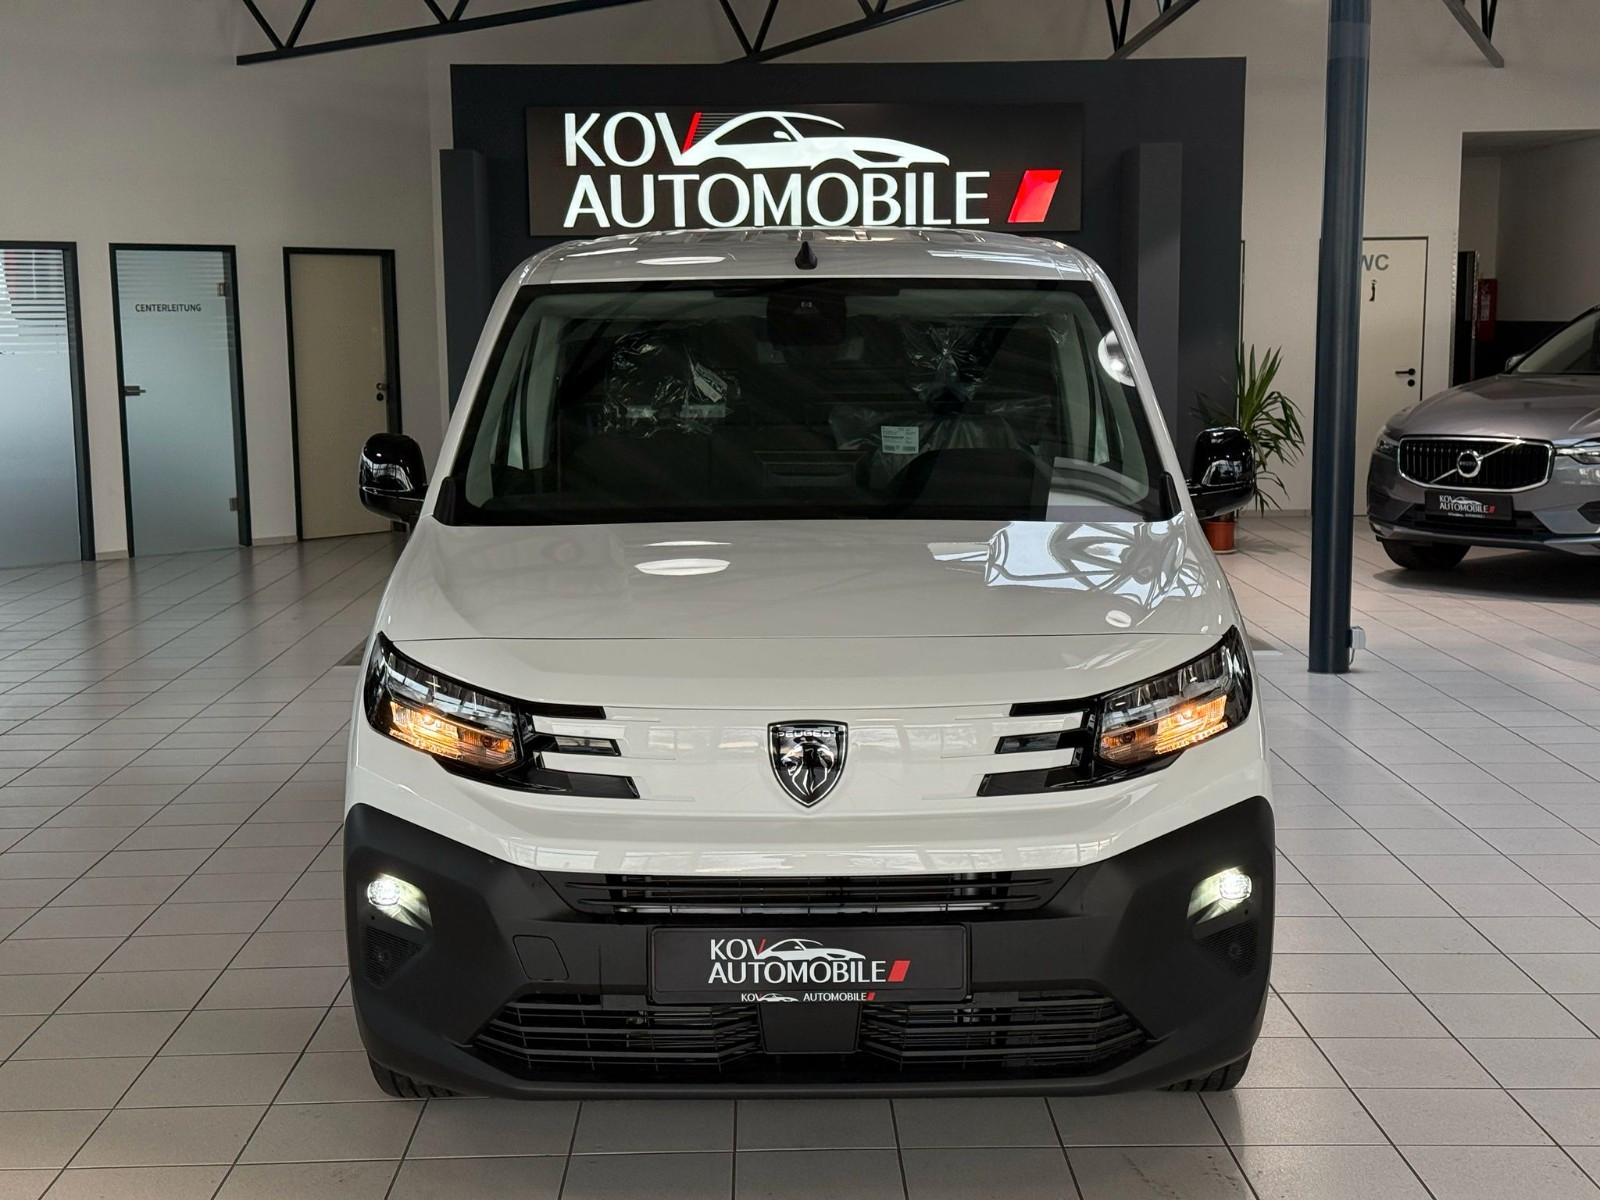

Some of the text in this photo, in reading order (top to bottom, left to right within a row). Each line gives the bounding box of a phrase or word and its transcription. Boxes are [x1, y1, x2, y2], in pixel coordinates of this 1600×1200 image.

[564, 111, 702, 167] KOV
[563, 171, 991, 228] AUTOMOBILE
[1360, 254, 1389, 271] WC
[135, 303, 202, 313] CENTERLEITUNG
[1440, 502, 1489, 513] AUTOMOBILE
[710, 938, 766, 960] KOV
[708, 961, 886, 984] AUTOMOBILE
[803, 992, 867, 1002] AUTOMOBILE
